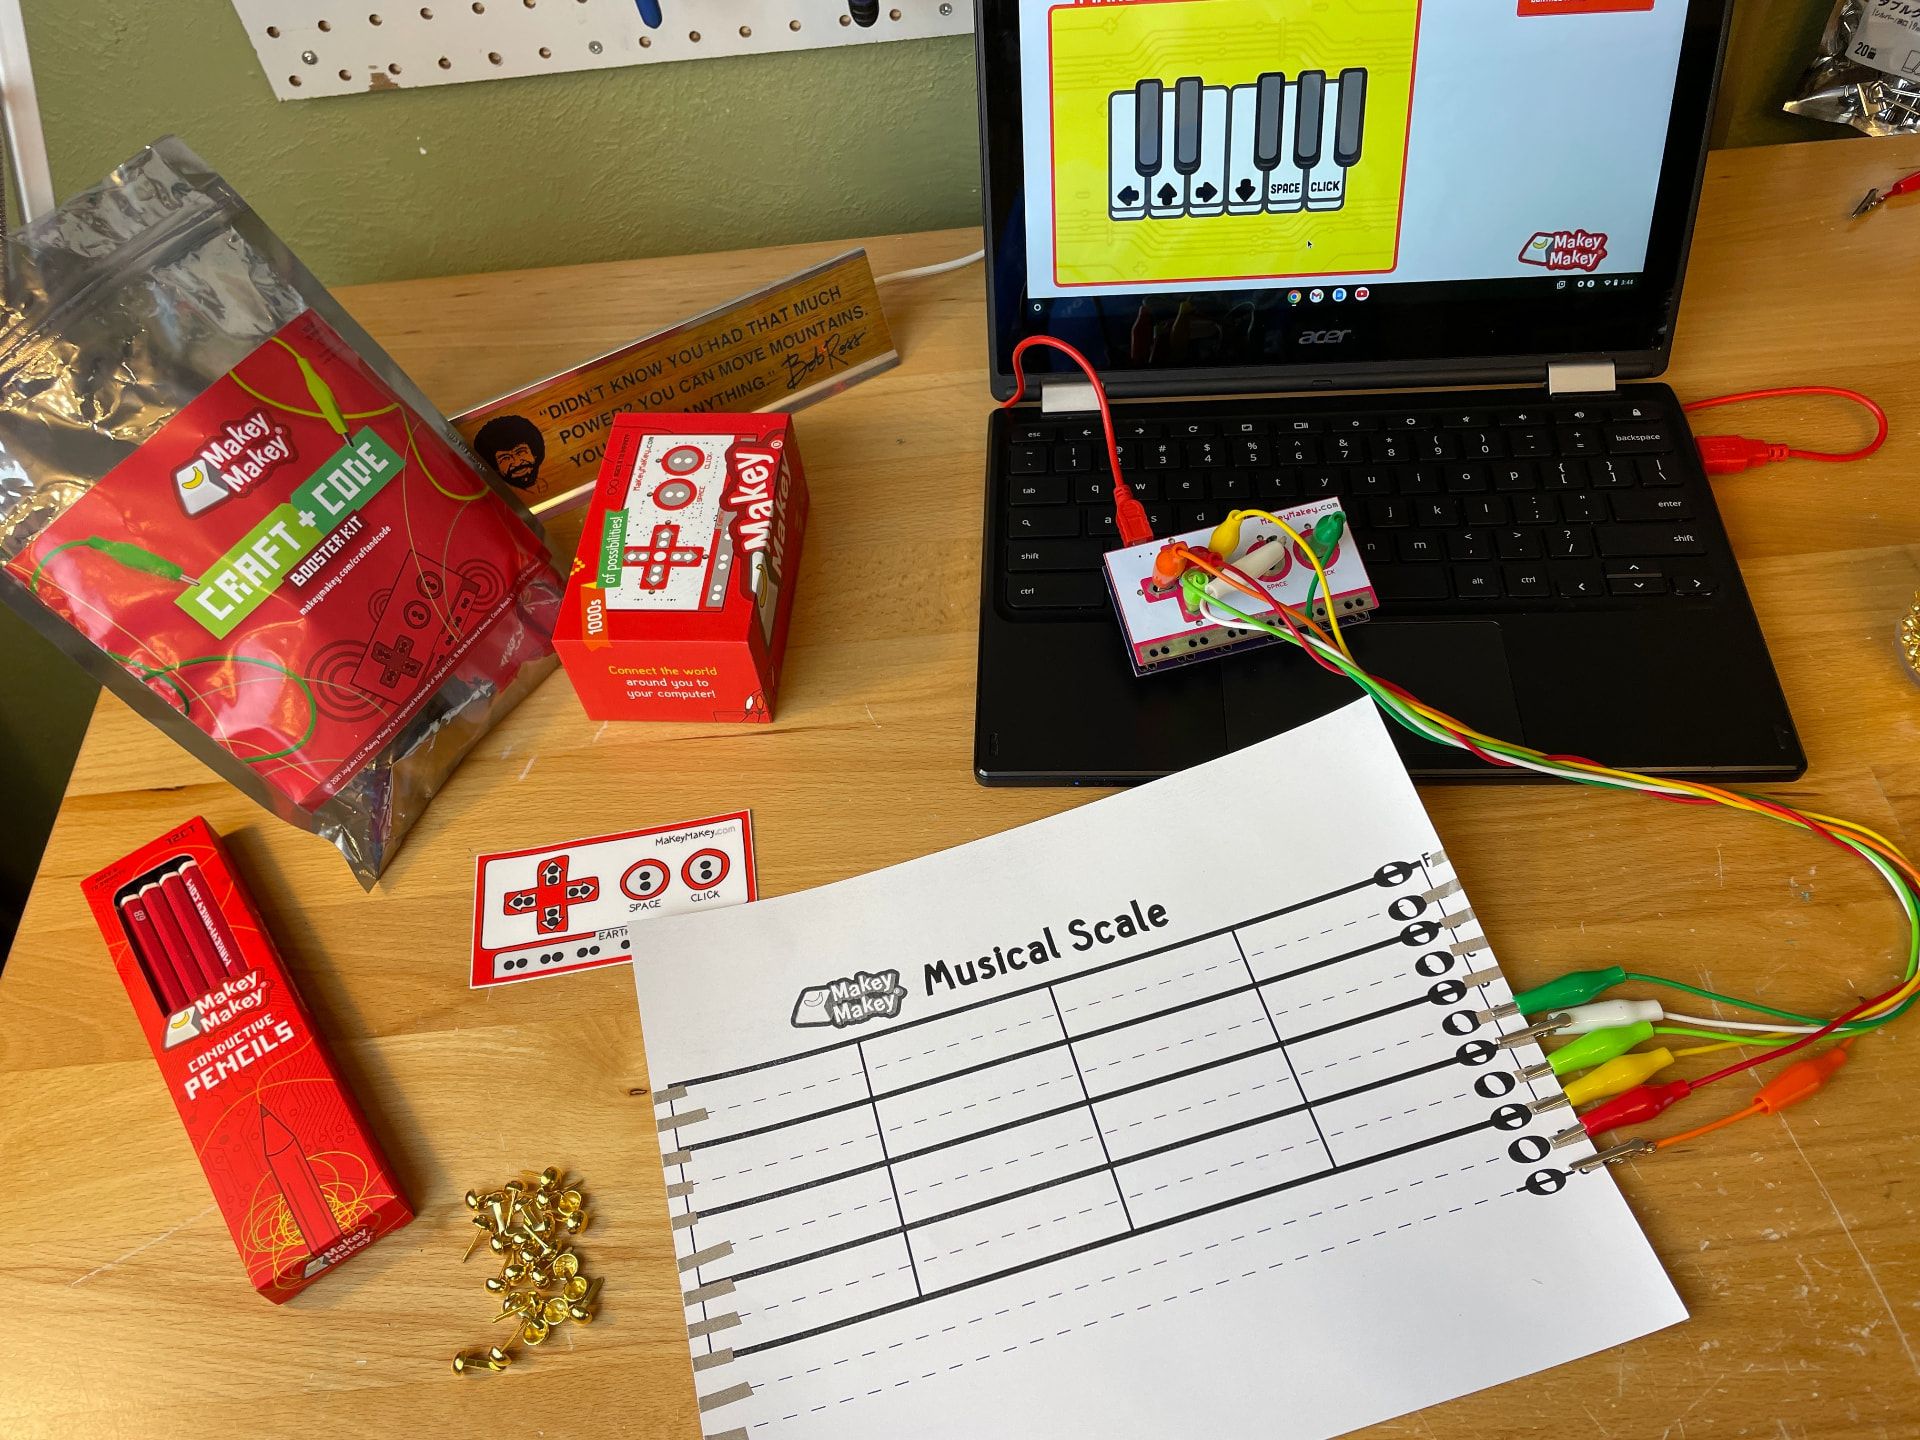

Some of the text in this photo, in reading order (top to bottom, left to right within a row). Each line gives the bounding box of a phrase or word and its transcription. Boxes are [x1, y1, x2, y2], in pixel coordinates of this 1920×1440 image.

[1270, 181, 1340, 194] SPACE CLICK
[1554, 233, 1602, 250] Makey
[1549, 250, 1598, 267] Makey
[1299, 329, 1352, 345] acer
[610, 364, 664, 400] KNOW
[667, 344, 705, 378] YOU
[707, 328, 743, 358] HAD
[745, 307, 791, 342] THAT
[794, 286, 842, 317] MUCH
[783, 345, 826, 390] Bob
[559, 305, 869, 444] POWER? YOU CAN MOVE MOUNTAINS.
[201, 411, 272, 470] Makey
[1339, 438, 1348, 447] &
[1615, 434, 1661, 442] backspace
[1203, 443, 1210, 452] $
[1248, 441, 1258, 450] %
[1434, 446, 1442, 455] 9
[1296, 452, 1303, 460] 6
[1341, 450, 1348, 458] 7
[1387, 448, 1395, 457] 8
[1072, 459, 1077, 467] 1
[1159, 456, 1167, 464] 3
[1204, 454, 1212, 463] 4
[1250, 454, 1257, 462] 5
[1367, 475, 1376, 483] u
[1510, 471, 1519, 480] p
[1135, 482, 1146, 490] w
[1182, 481, 1190, 489] e
[1228, 479, 1235, 488] r
[1276, 478, 1281, 487] t
[1321, 477, 1329, 487] y
[1022, 487, 1036, 495] tab
[1091, 484, 1099, 494] q
[771, 449, 793, 579] Makey
[1260, 502, 1339, 526] MaeyMakey.com
[1388, 506, 1393, 518] j
[1434, 505, 1441, 515] k
[1104, 515, 1112, 524] a
[1150, 514, 1157, 523] s
[1196, 511, 1205, 521] d
[195, 520, 301, 621] CRAFT
[298, 510, 316, 528] +
[311, 441, 389, 516] CODE
[1563, 530, 1571, 539] ?
[1673, 534, 1695, 542] shift
[1367, 542, 1376, 550] n
[1414, 541, 1427, 549] m
[290, 515, 363, 587] BOOSTER KIT
[1021, 552, 1039, 560] shift
[299, 525, 392, 616] makeymakey.com/craftandcode
[586, 514, 624, 636] 1000s of possibilities!
[1472, 577, 1484, 585] alt
[1521, 576, 1536, 584] ctrl
[1267, 581, 1288, 590] SPACE
[1020, 587, 1034, 595] ctrl
[608, 665, 718, 676] Connect the world
[626, 678, 709, 689] around you to
[627, 690, 716, 700] your computer!
[363, 737, 379, 753] Makey
[395, 699, 416, 721] registered
[412, 682, 432, 703] trademark
[166, 824, 195, 846] 12CT
[1421, 852, 1433, 868] F
[629, 890, 721, 912] SPACE CLICK
[924, 899, 1169, 996] Musical Scale
[829, 972, 893, 1001] Makey
[195, 971, 256, 1015] Makey
[200, 988, 262, 1033] Makey
[188, 1013, 275, 1073] CONDUCTIVE
[184, 1020, 294, 1100] PENCILS
[323, 1228, 366, 1258] Makey
[329, 1236, 371, 1263] Makey
